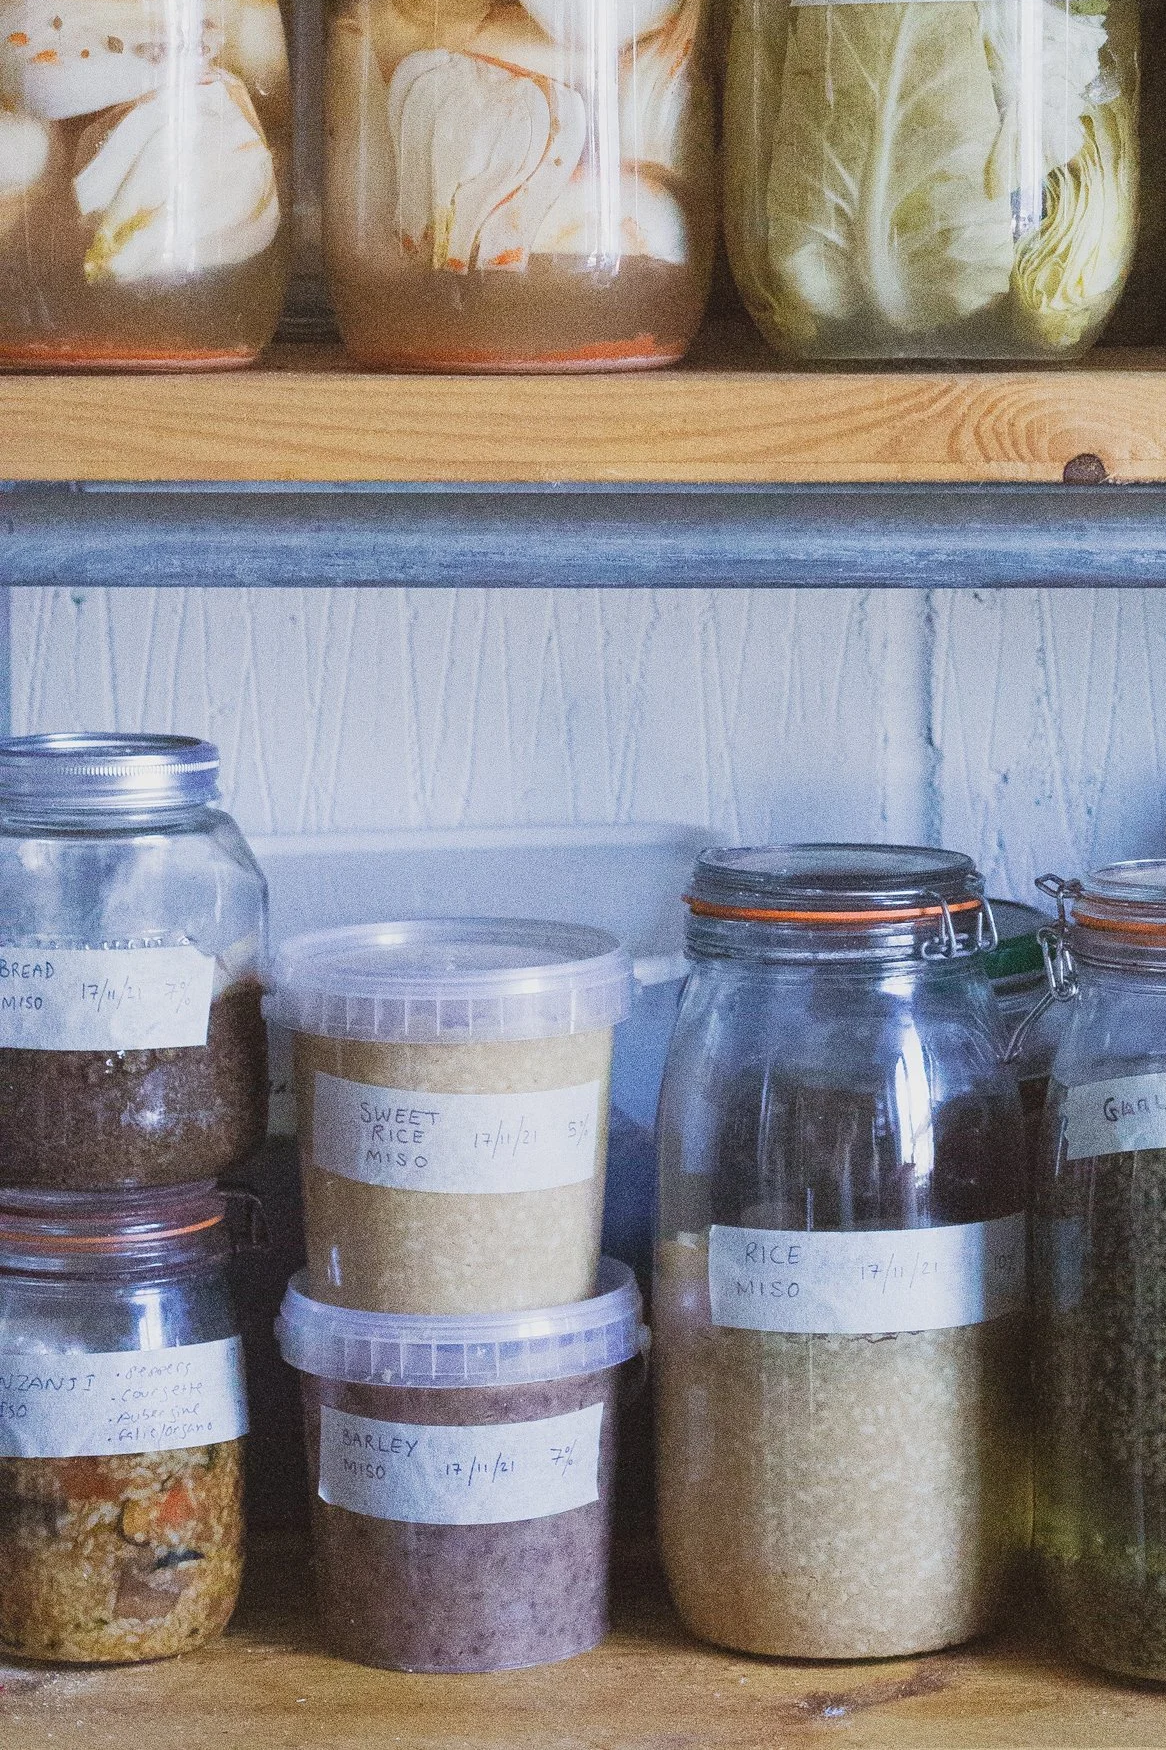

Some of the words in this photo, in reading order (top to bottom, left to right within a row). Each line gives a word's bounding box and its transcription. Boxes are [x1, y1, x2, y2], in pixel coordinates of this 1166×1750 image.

[0, 958, 55, 979] BREAD
[2, 996, 43, 1010] MISO
[82, 975, 142, 1013] 17/11/21
[360, 1101, 440, 1126] SWEET
[371, 1124, 425, 1144] RICE
[473, 1115, 537, 1159] 17/11/21
[567, 1113, 591, 1146] 5%
[365, 1149, 428, 1168] MISO
[744, 1241, 801, 1265] RICE
[735, 1279, 800, 1299] MISO
[860, 1252, 939, 1295] 17/11/21
[341, 1428, 419, 1457] BARLEY
[342, 1458, 386, 1480] MISO
[445, 1452, 515, 1487] 17/11/21
[550, 1439, 578, 1477] 7%
